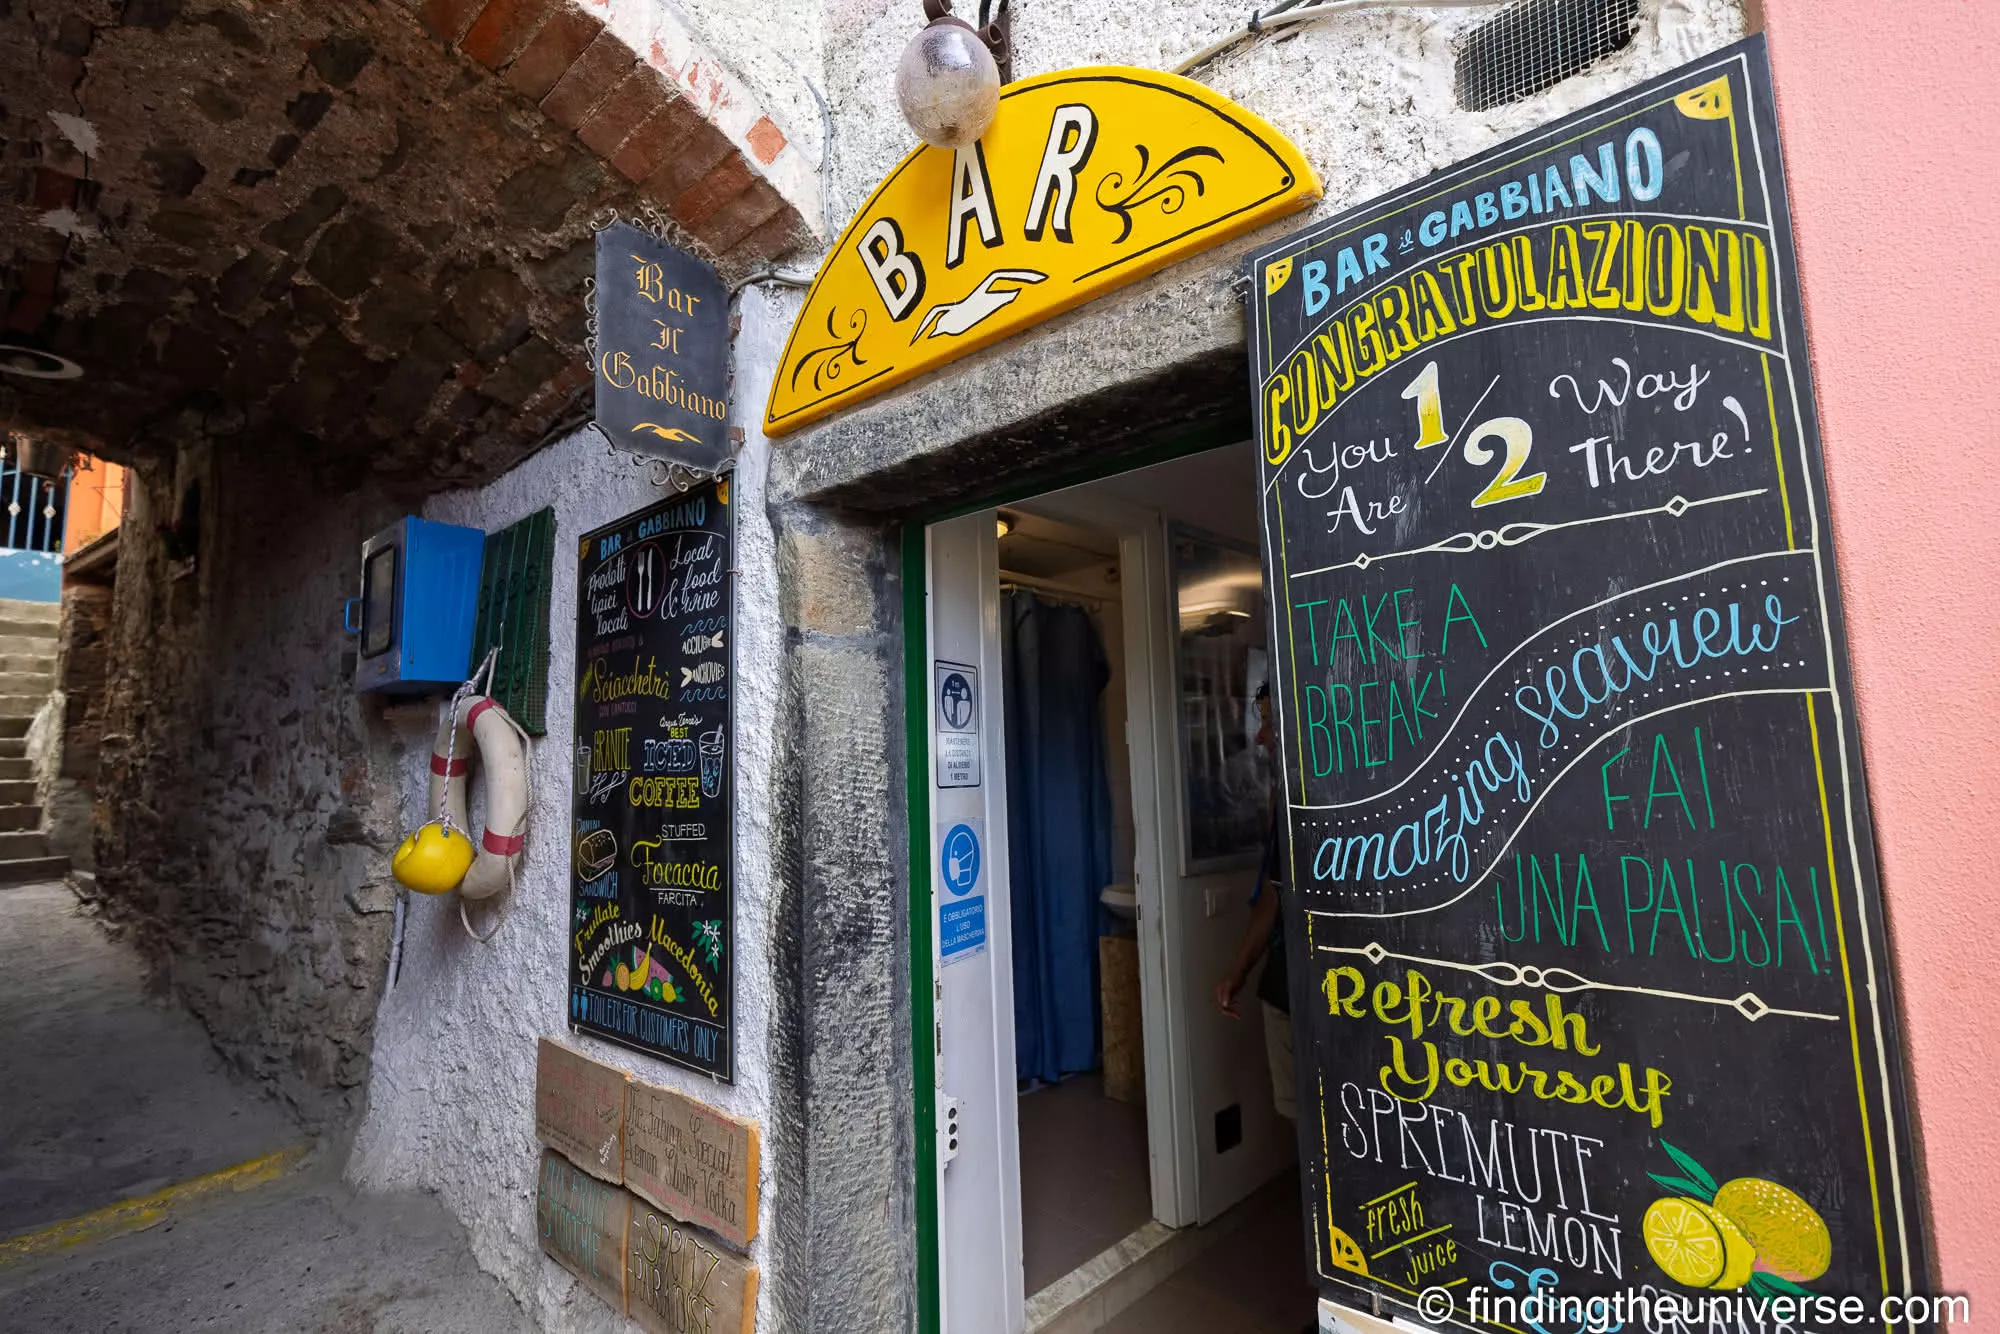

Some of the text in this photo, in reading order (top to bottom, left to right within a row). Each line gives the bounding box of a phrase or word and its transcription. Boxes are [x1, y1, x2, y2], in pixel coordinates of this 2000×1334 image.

[856, 103, 1099, 322] BAR
[1301, 126, 1665, 318] BAR il GABBIANO
[631, 254, 701, 317] Bar
[650, 319, 684, 355] Il
[1264, 220, 1773, 466] CONGRATULAZIONI
[601, 351, 727, 421] Gabbiano
[1549, 357, 1711, 414] Way
[1400, 361, 1547, 508] 1/2
[1569, 395, 1754, 488] There!
[1298, 437, 1398, 499] You
[600, 533, 621, 561] BAR
[638, 496, 706, 539] GABBIANO
[1326, 486, 1407, 535] Are
[587, 553, 627, 601] Prodotti
[670, 535, 714, 570] Local
[681, 557, 723, 604] food
[590, 589, 618, 618] tipici
[596, 606, 629, 636] locali
[661, 578, 720, 620] & wine
[1295, 583, 1489, 666] TAKE A
[593, 727, 632, 772] GRANITE
[643, 739, 697, 772] ICED
[670, 727, 689, 739] BEST
[1305, 669, 1449, 777] BREAK!
[1313, 594, 1800, 883] amazing seaview
[629, 776, 700, 809] COFFEE
[1601, 726, 1716, 830] FAI
[631, 835, 722, 891] Focaccia
[661, 823, 706, 838] STUFFED
[575, 901, 621, 953] Frullate
[658, 892, 697, 906] FARCITA
[1496, 854, 1831, 976] UNA PAUSA!
[578, 921, 643, 986] Smoothies
[648, 914, 719, 1017] Macedonia
[588, 993, 719, 1064] TOILETS FOR CUSTOMERS ONLY
[1321, 966, 1601, 1056] Refresh
[1379, 1035, 1672, 1128] Yourself
[1341, 1082, 1619, 1224] SPREMUTE
[641, 1212, 720, 1297] SPRITZ
[1476, 1195, 1622, 1280] LEMON
